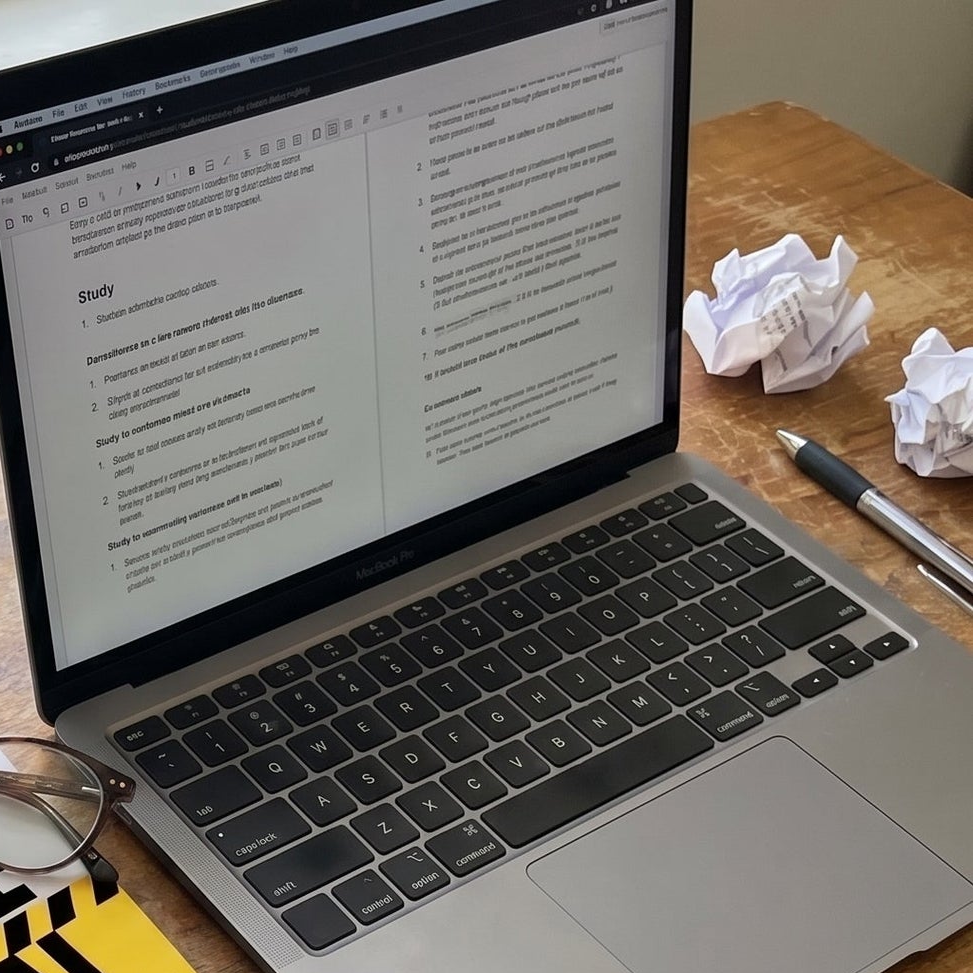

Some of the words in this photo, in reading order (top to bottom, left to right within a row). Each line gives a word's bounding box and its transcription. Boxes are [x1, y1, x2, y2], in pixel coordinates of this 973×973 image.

[77, 282, 115, 305] Study
[95, 433, 120, 449] Study
[107, 536, 132, 552] Study
[259, 722, 274, 733] 2
[303, 703, 317, 714] 3
[349, 683, 360, 693] 4
[389, 663, 402, 674] 5
[432, 645, 445, 655] 6
[470, 626, 482, 637] 7
[511, 609, 524, 619] 8
[549, 591, 562, 602] 9
[268, 762, 284, 774] Q
[309, 740, 328, 754] W
[356, 721, 371, 733] E
[399, 702, 414, 714] R
[440, 682, 454, 693] T
[482, 663, 496, 674] Y
[522, 644, 537, 656] U
[638, 591, 650, 602] P
[317, 795, 331, 807] A
[361, 773, 376, 785] S
[404, 752, 419, 765] D
[448, 731, 459, 743] F
[490, 711, 505, 723] G
[530, 691, 547, 704] H
[575, 673, 586, 684] J
[611, 654, 627, 666] K
[650, 637, 665, 647] L
[376, 821, 393, 835] Z
[421, 799, 439, 813] X
[467, 778, 481, 790] C
[508, 755, 523, 768] V
[551, 736, 566, 748] B
[591, 716, 608, 729] N
[631, 695, 649, 709] M
